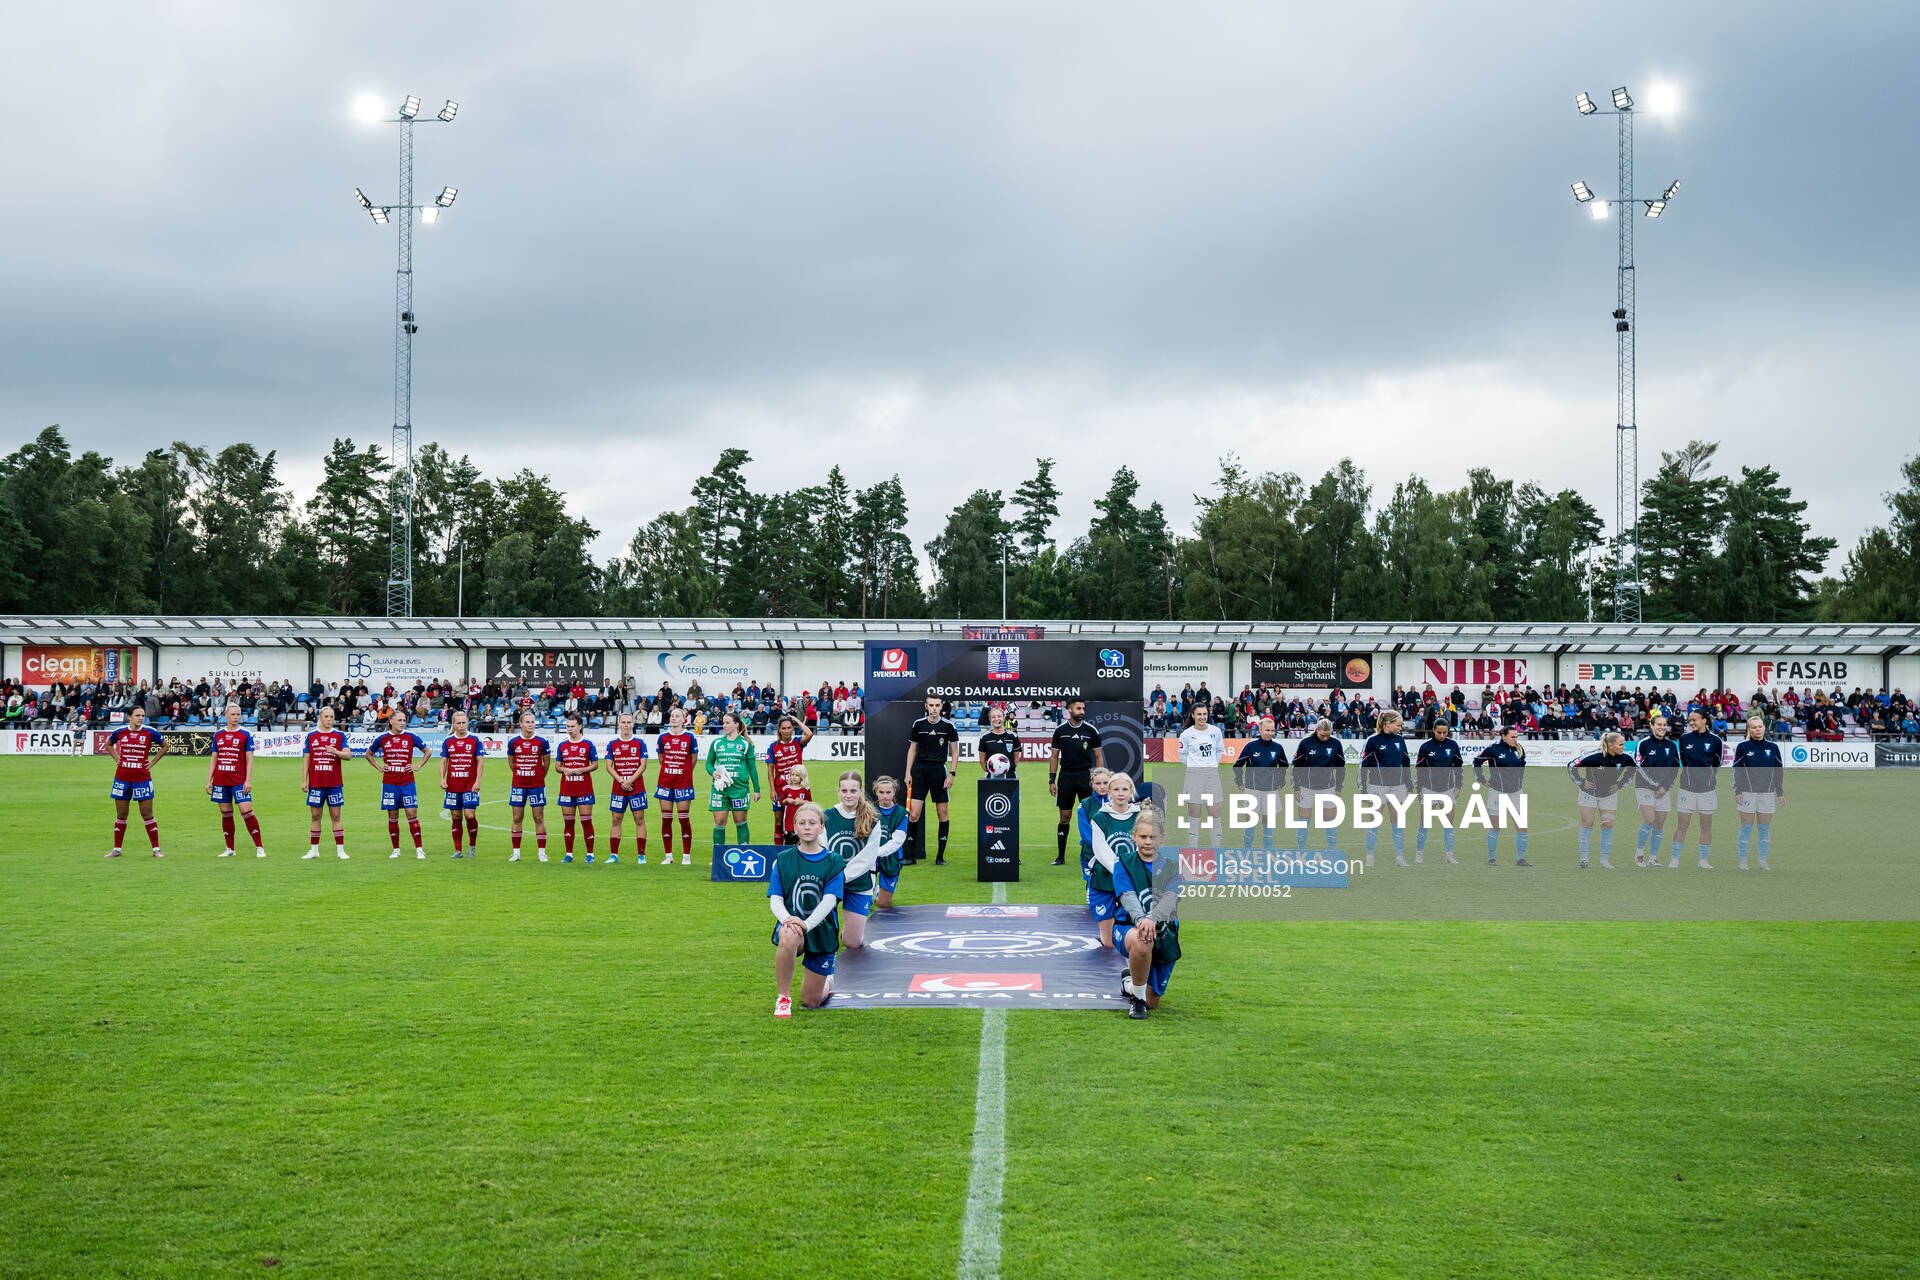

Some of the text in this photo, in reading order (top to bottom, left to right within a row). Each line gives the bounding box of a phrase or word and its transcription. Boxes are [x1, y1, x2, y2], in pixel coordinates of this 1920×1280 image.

[26, 654, 87, 672] clean
[520, 651, 597, 667] KREATIV
[1254, 659, 1337, 671] Snapphanebygdens
[521, 669, 593, 678] REKLAM
[678, 665, 749, 676] Vittsjö Omsorg
[872, 670, 916, 678] SVENSKA SPEL
[1096, 668, 1131, 679] OBOS
[1167, 663, 1209, 671] kommun
[1422, 658, 1527, 685] NIBE
[1591, 664, 1681, 681] PEAB
[1776, 661, 1848, 679] FASAB
[1294, 670, 1336, 682] Sparbank
[926, 686, 1081, 696] OBOS DAMALLSVENSKAN
[30, 733, 83, 747] FASA
[831, 742, 865, 757] SVEN
[1810, 748, 1869, 763] Brinova
[1224, 850, 1325, 866] SVENSKA
[1225, 868, 1279, 884] SPEL
